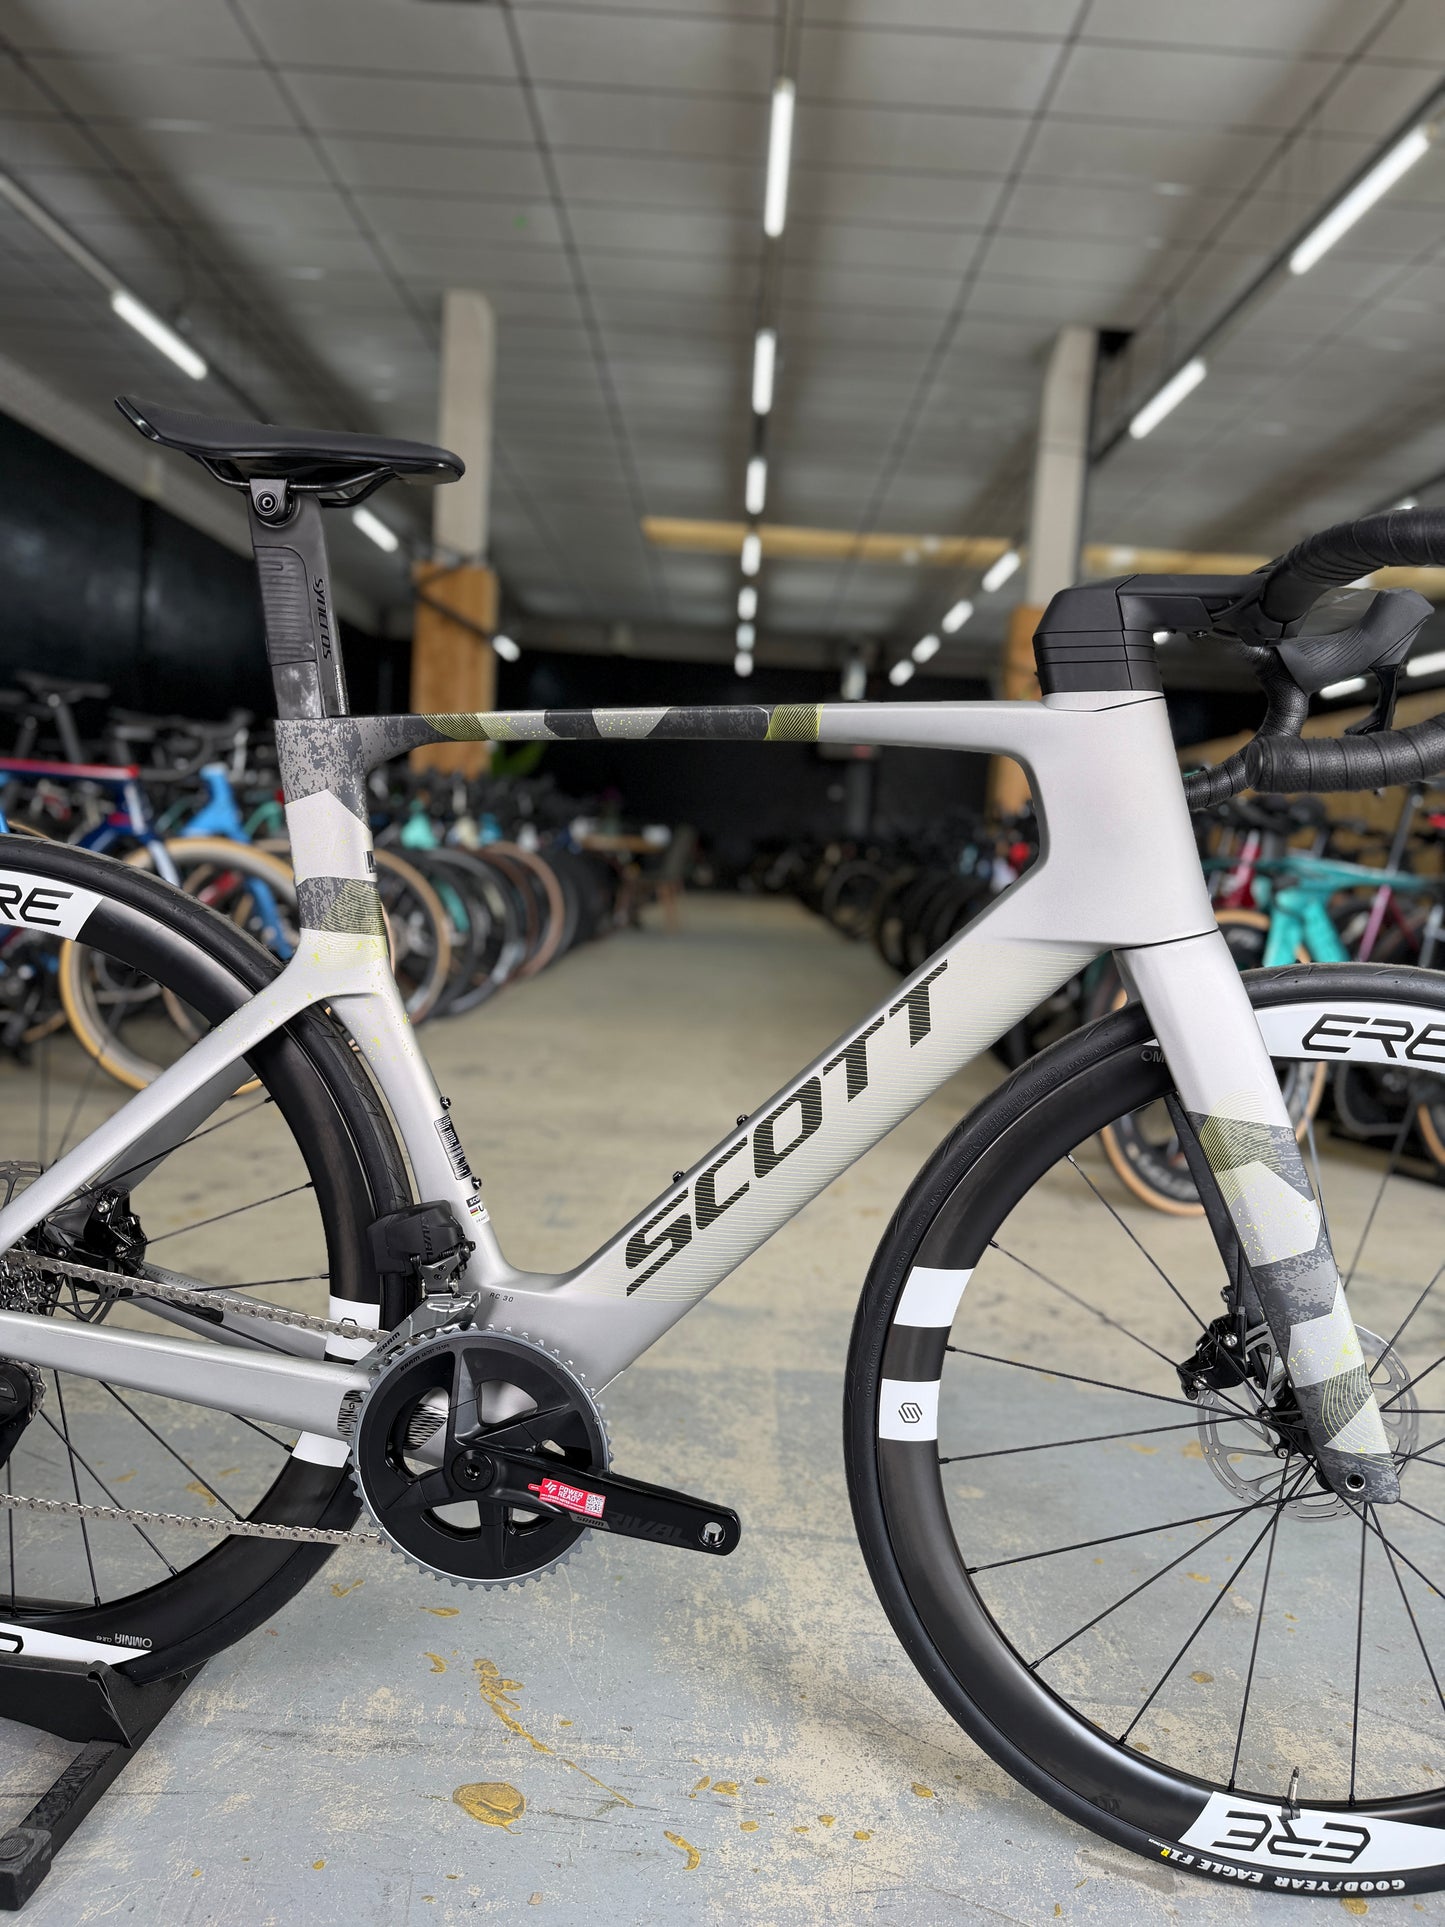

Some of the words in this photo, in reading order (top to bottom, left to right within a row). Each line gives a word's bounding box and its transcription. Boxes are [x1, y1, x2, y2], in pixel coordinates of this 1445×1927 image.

[624, 958, 949, 1298] SCOTT
[502, 1295, 515, 1303] 30
[557, 1490, 581, 1504] READY
[558, 1485, 584, 1500] POWER
[114, 1632, 153, 1648] OMNIA
[1210, 1810, 1372, 1865] ERE
[1198, 1857, 1264, 1884] EAGLE
